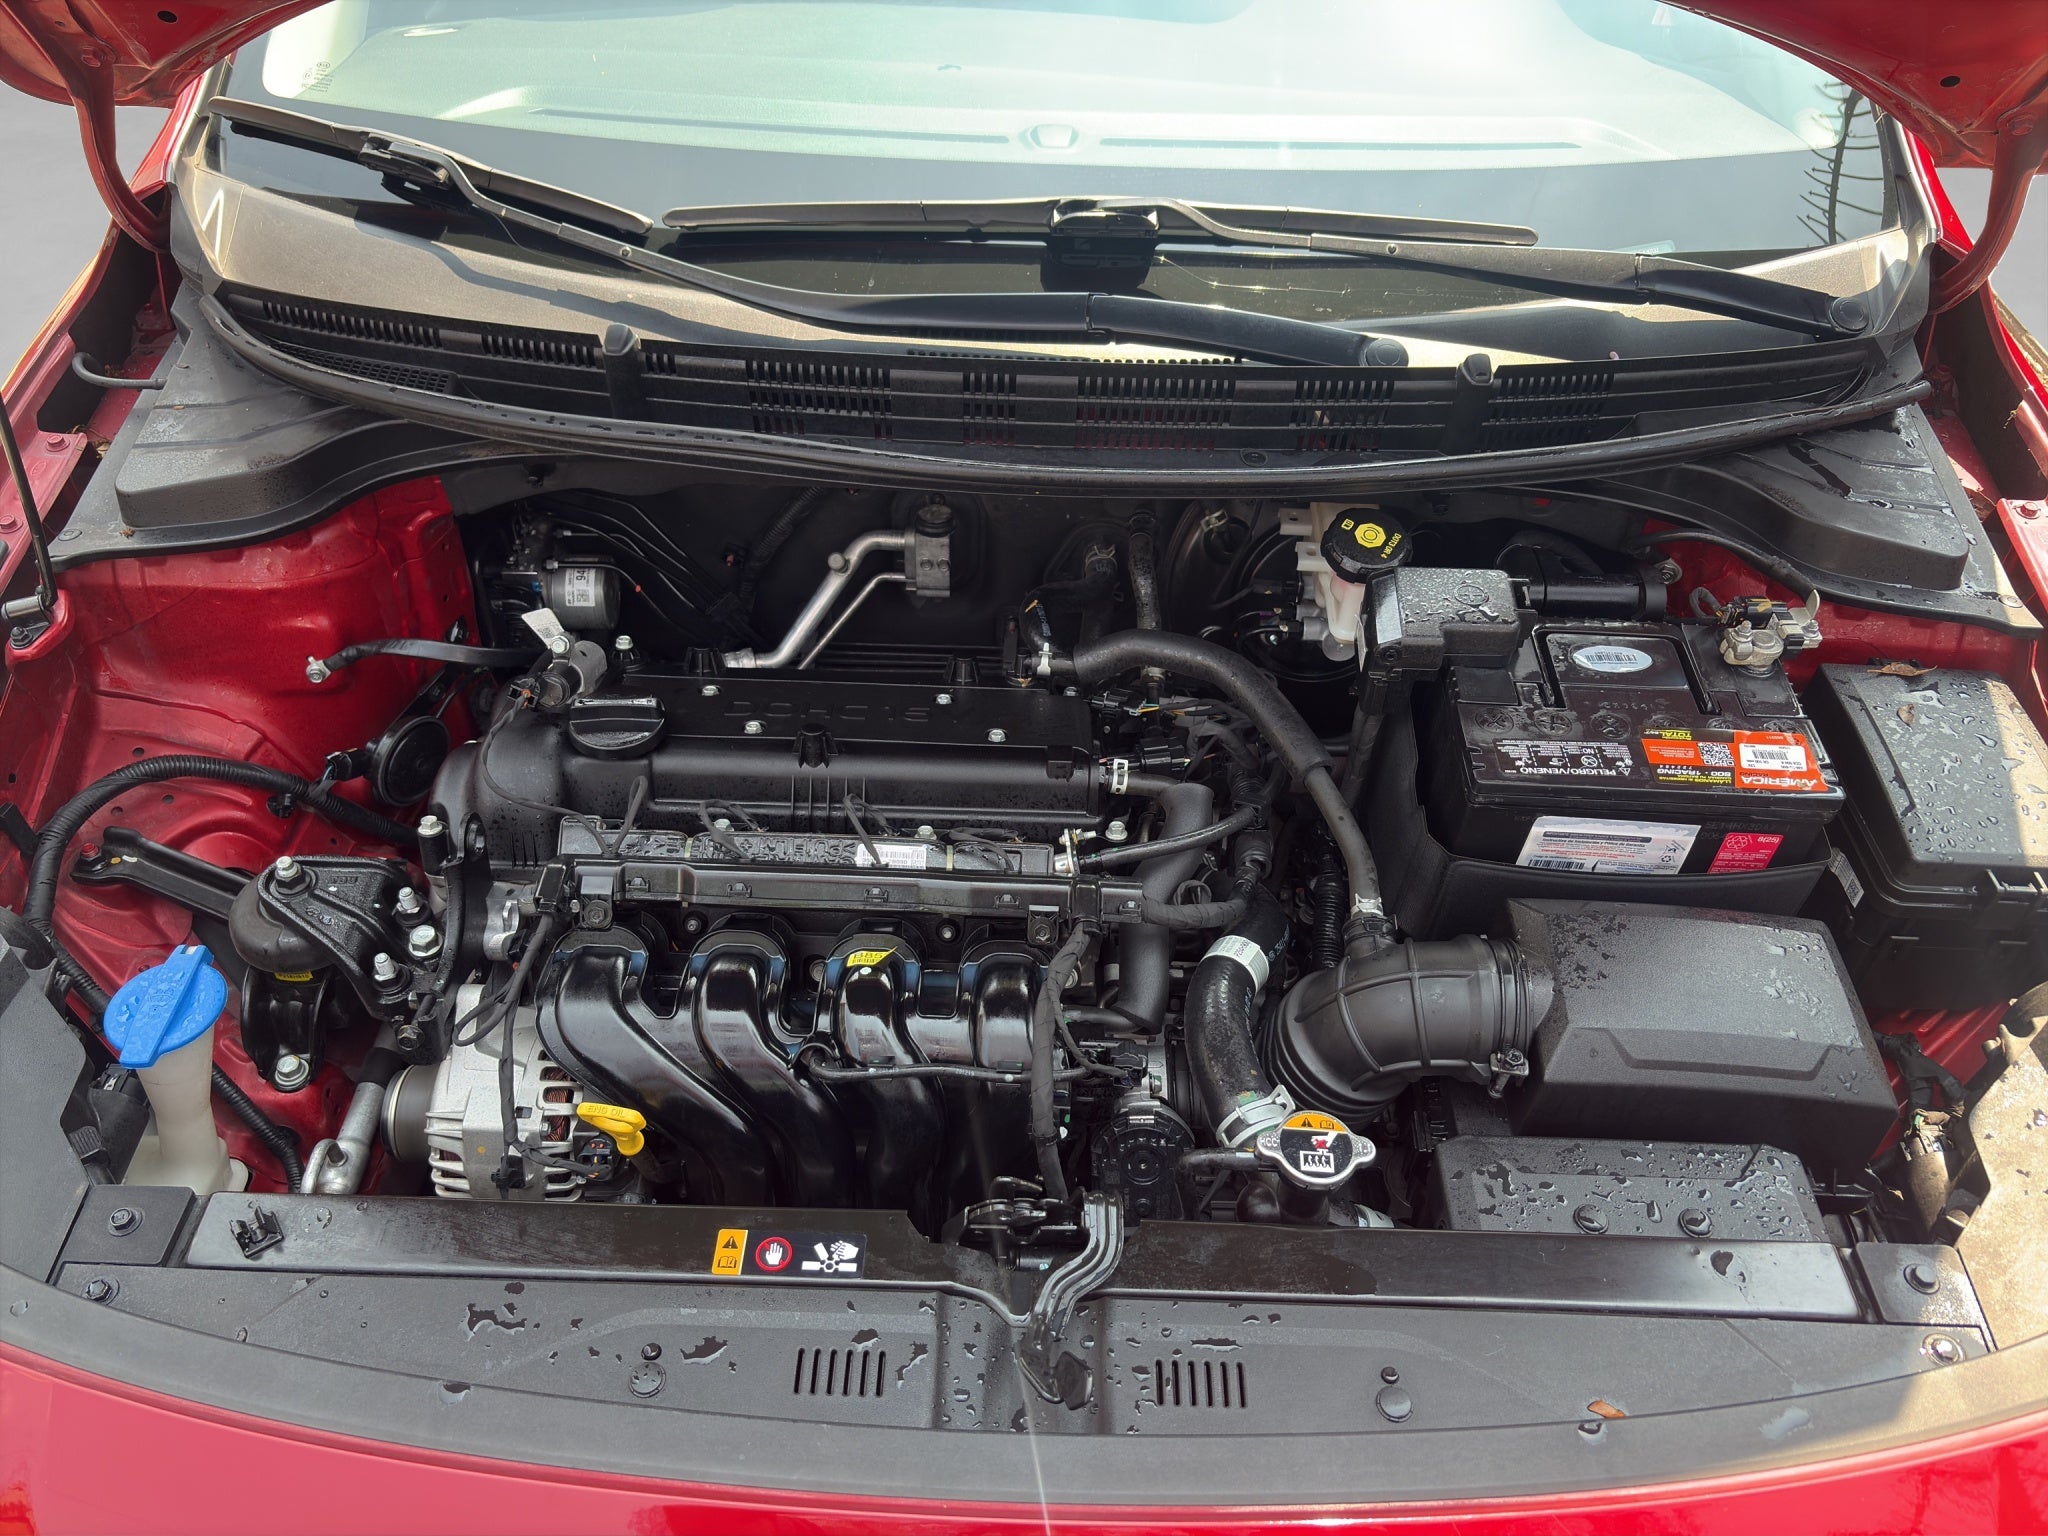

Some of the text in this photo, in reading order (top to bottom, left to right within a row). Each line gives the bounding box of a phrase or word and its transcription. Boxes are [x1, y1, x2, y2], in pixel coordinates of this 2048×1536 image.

[1520, 767, 1616, 775] PELIGRO/VENENO
[586, 1105, 625, 1118] ENG OIL
